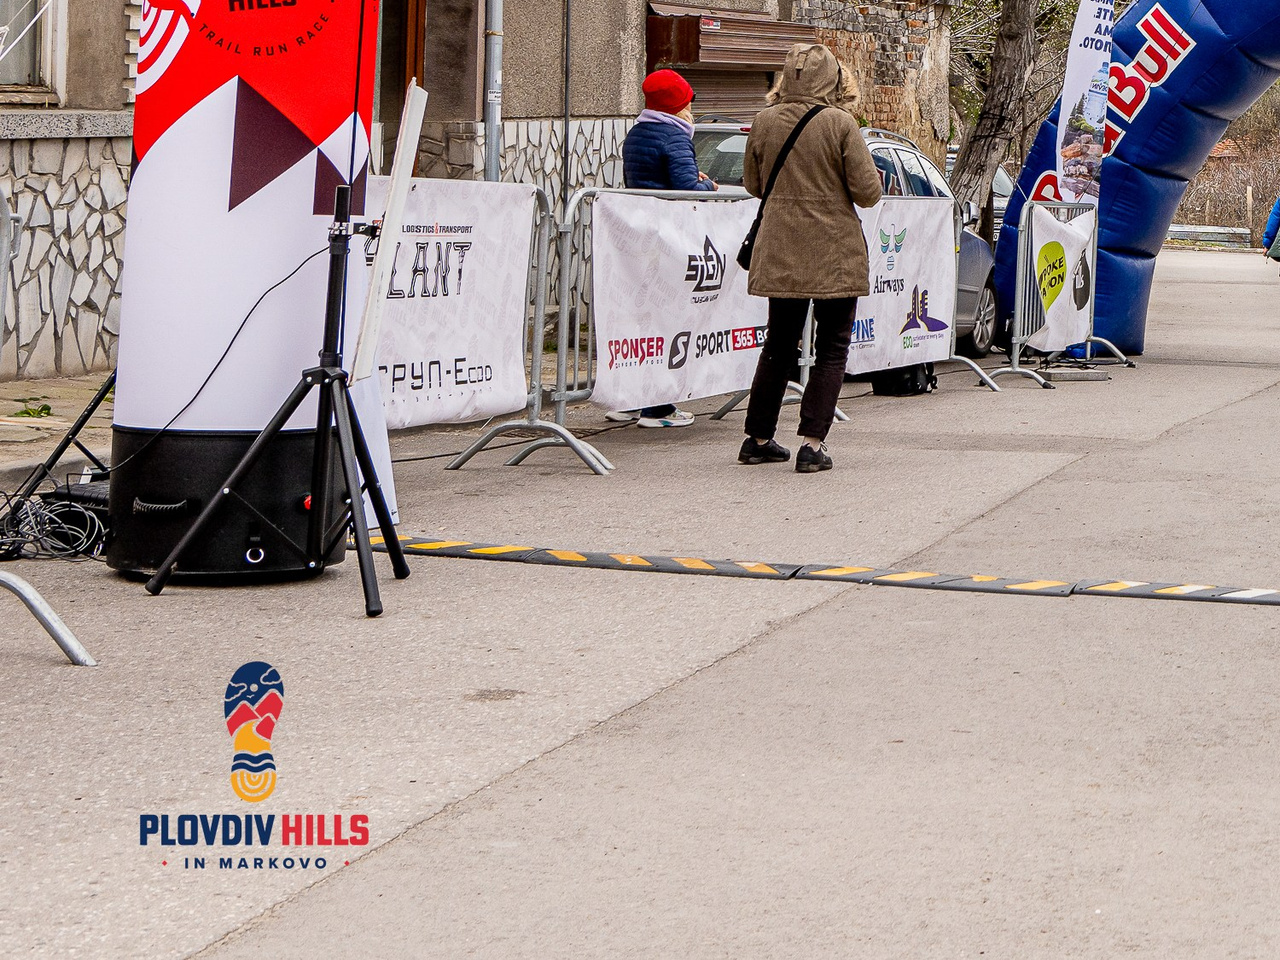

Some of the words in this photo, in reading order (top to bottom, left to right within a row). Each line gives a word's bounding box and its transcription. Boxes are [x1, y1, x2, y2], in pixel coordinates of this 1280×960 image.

[199, 23, 242, 55] TRAIL
[253, 45, 288, 57] RUN
[296, 13, 329, 47] RACE
[1107, 7, 1191, 119] Bull
[874, 275, 904, 296] Airways
[608, 337, 664, 370] SPONSER
[695, 330, 731, 358] SPORT
